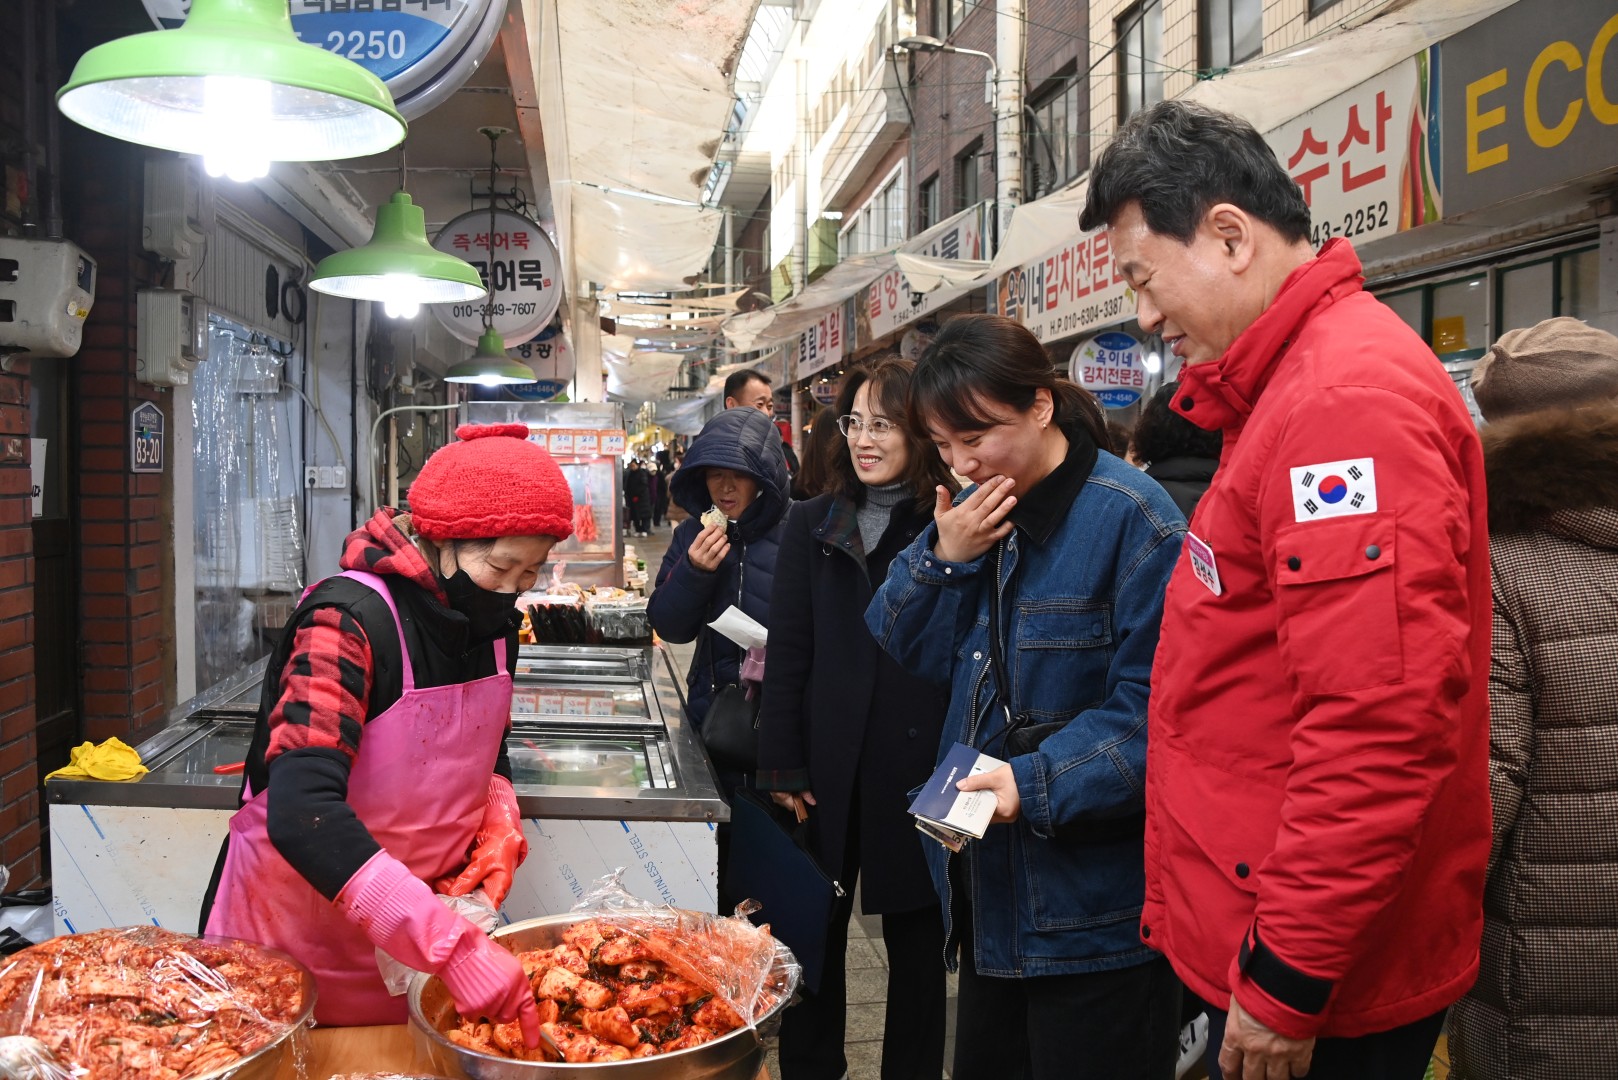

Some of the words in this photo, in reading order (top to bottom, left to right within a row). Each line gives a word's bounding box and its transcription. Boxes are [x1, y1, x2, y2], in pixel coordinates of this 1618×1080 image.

[296, 30, 406, 60] -2250
[1288, 90, 1392, 208] 수산
[453, 232, 530, 251] 즉석어묵
[517, 344, 552, 359] 영광
[1096, 350, 1132, 367] 옥이네
[1084, 366, 1143, 387] 김치전문점
[136, 437, 160, 464] 83-20
[628, 833, 649, 860] STEEL
[643, 861, 676, 905] STAINLESS
